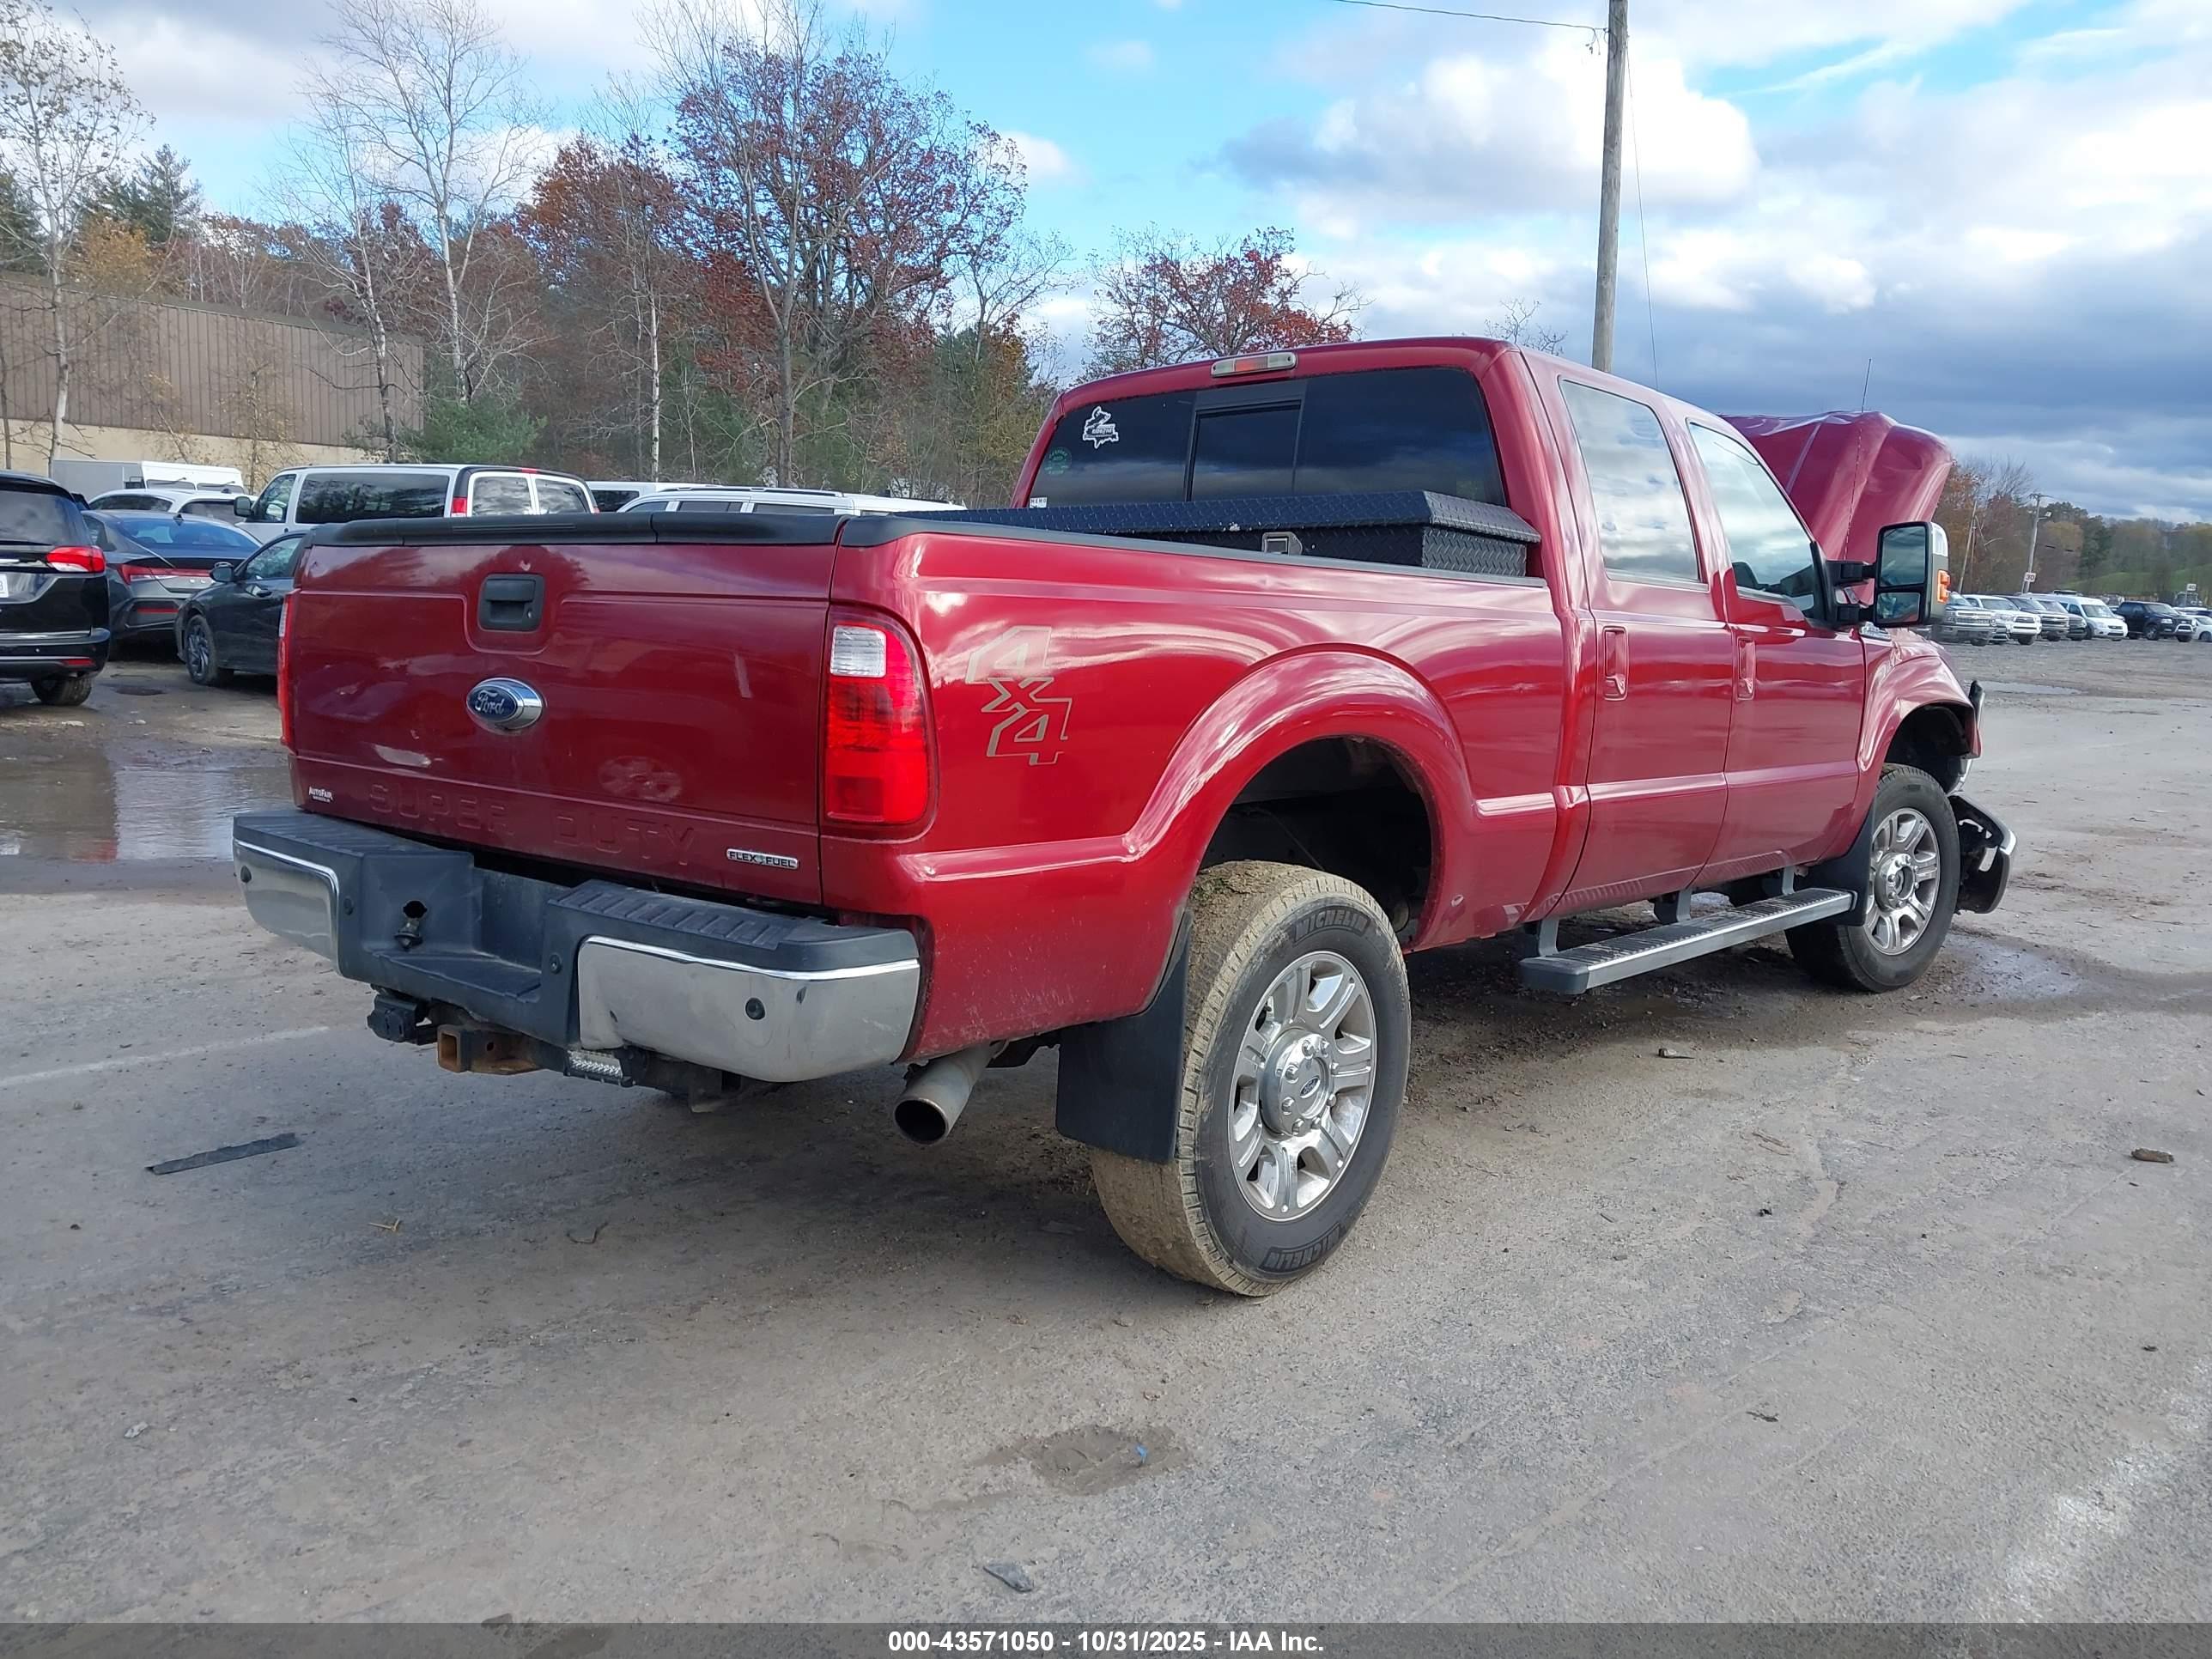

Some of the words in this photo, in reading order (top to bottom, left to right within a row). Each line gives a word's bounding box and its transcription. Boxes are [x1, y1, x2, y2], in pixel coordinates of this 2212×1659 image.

[475, 690, 505, 714] Ford
[370, 782, 514, 837] SUPER
[553, 811, 695, 866] DUTY
[729, 851, 757, 862] FLEX
[765, 856, 795, 868] FUEL
[1293, 908, 1370, 943] MICHELIN
